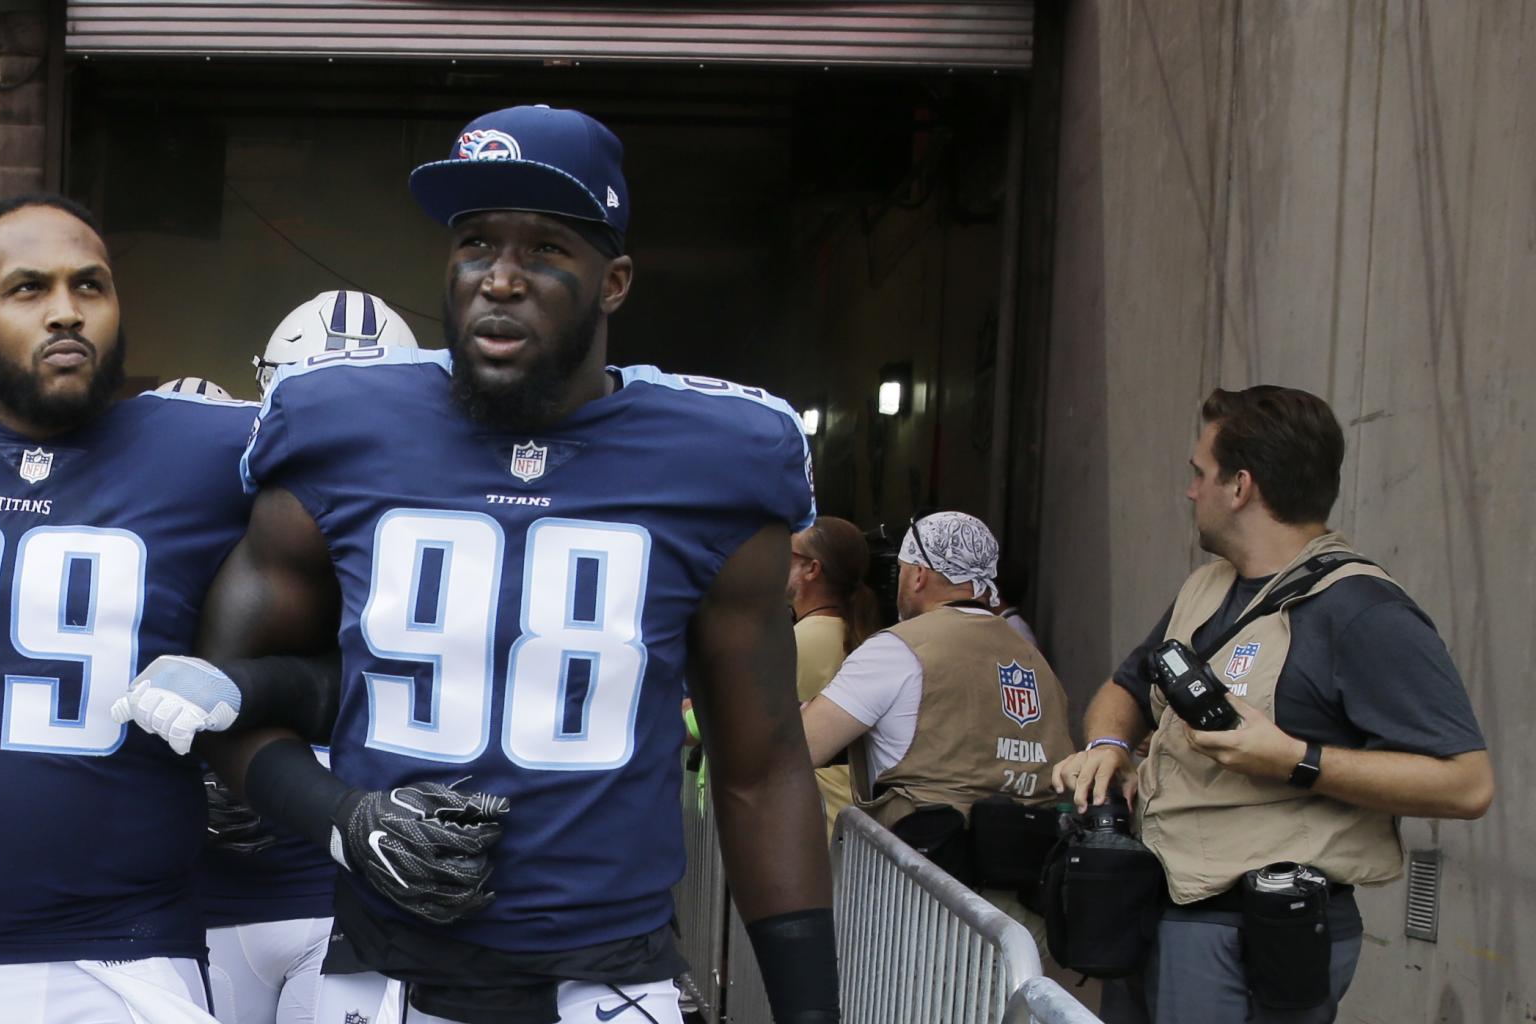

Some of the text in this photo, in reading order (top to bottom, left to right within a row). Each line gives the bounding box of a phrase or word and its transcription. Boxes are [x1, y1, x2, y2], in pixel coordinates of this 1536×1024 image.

[485, 494, 552, 508] TITANS
[360, 507, 652, 771] 98
[1004, 686, 1037, 718] NFL
[996, 737, 1048, 763] MEDIA
[999, 769, 1038, 797] 240
